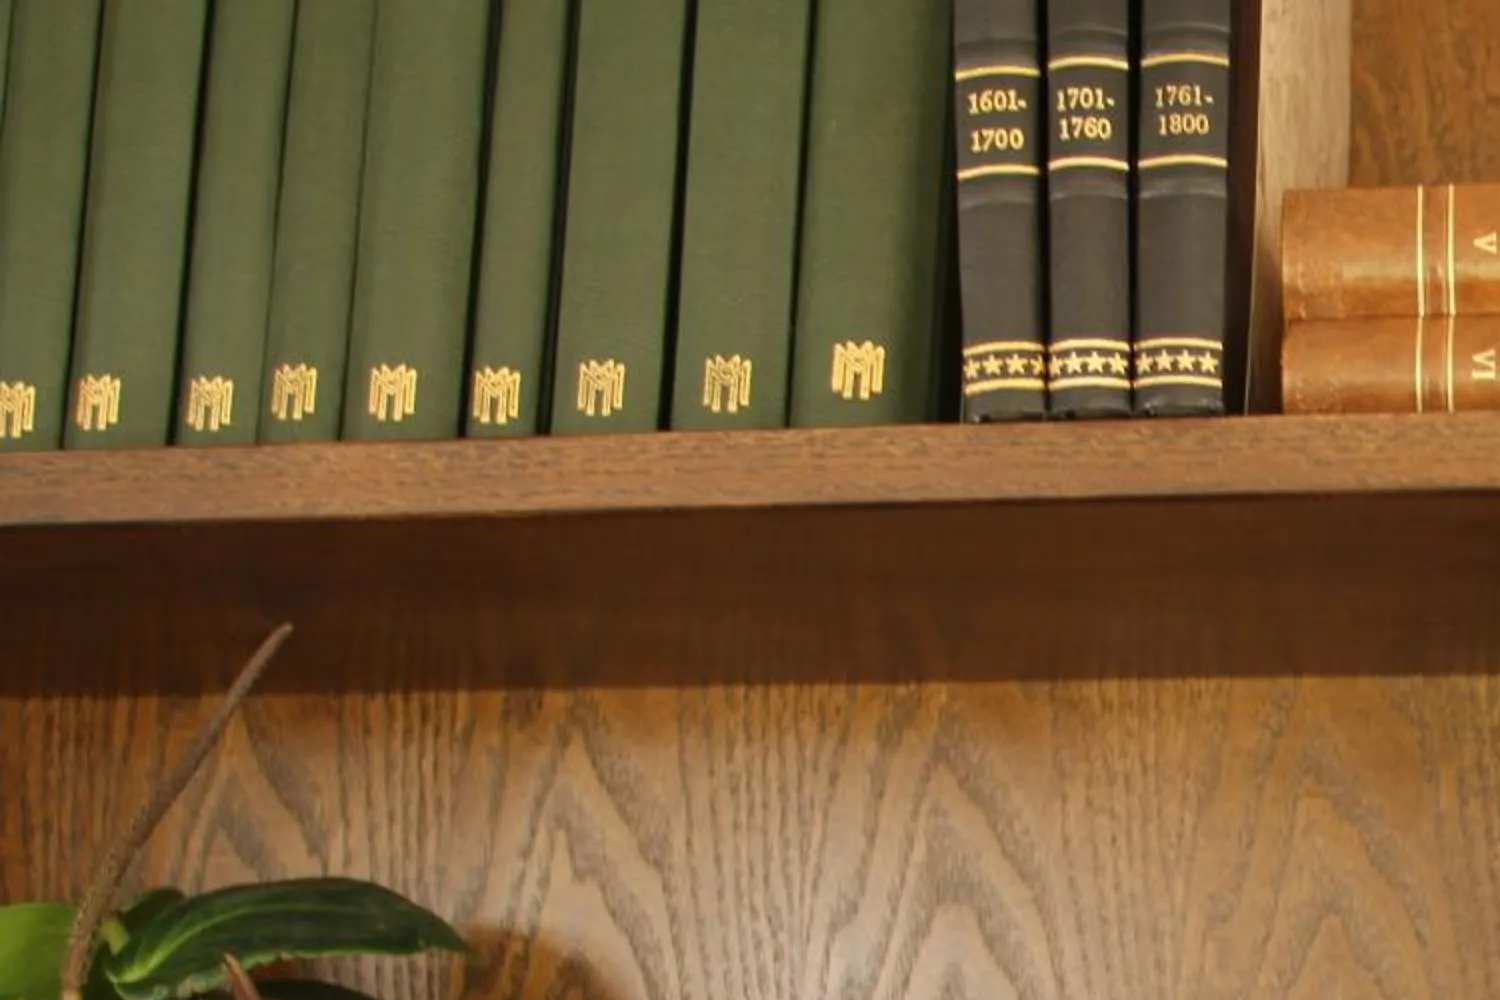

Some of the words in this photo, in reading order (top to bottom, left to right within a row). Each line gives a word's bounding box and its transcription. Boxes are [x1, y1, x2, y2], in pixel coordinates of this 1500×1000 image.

[967, 89, 1027, 115] 1601-
[1056, 87, 1115, 111] 1701-
[1154, 85, 1214, 108] 1761-
[1058, 116, 1112, 140] 1760
[1158, 113, 1209, 135] 1800
[970, 128, 1025, 152] 1700
